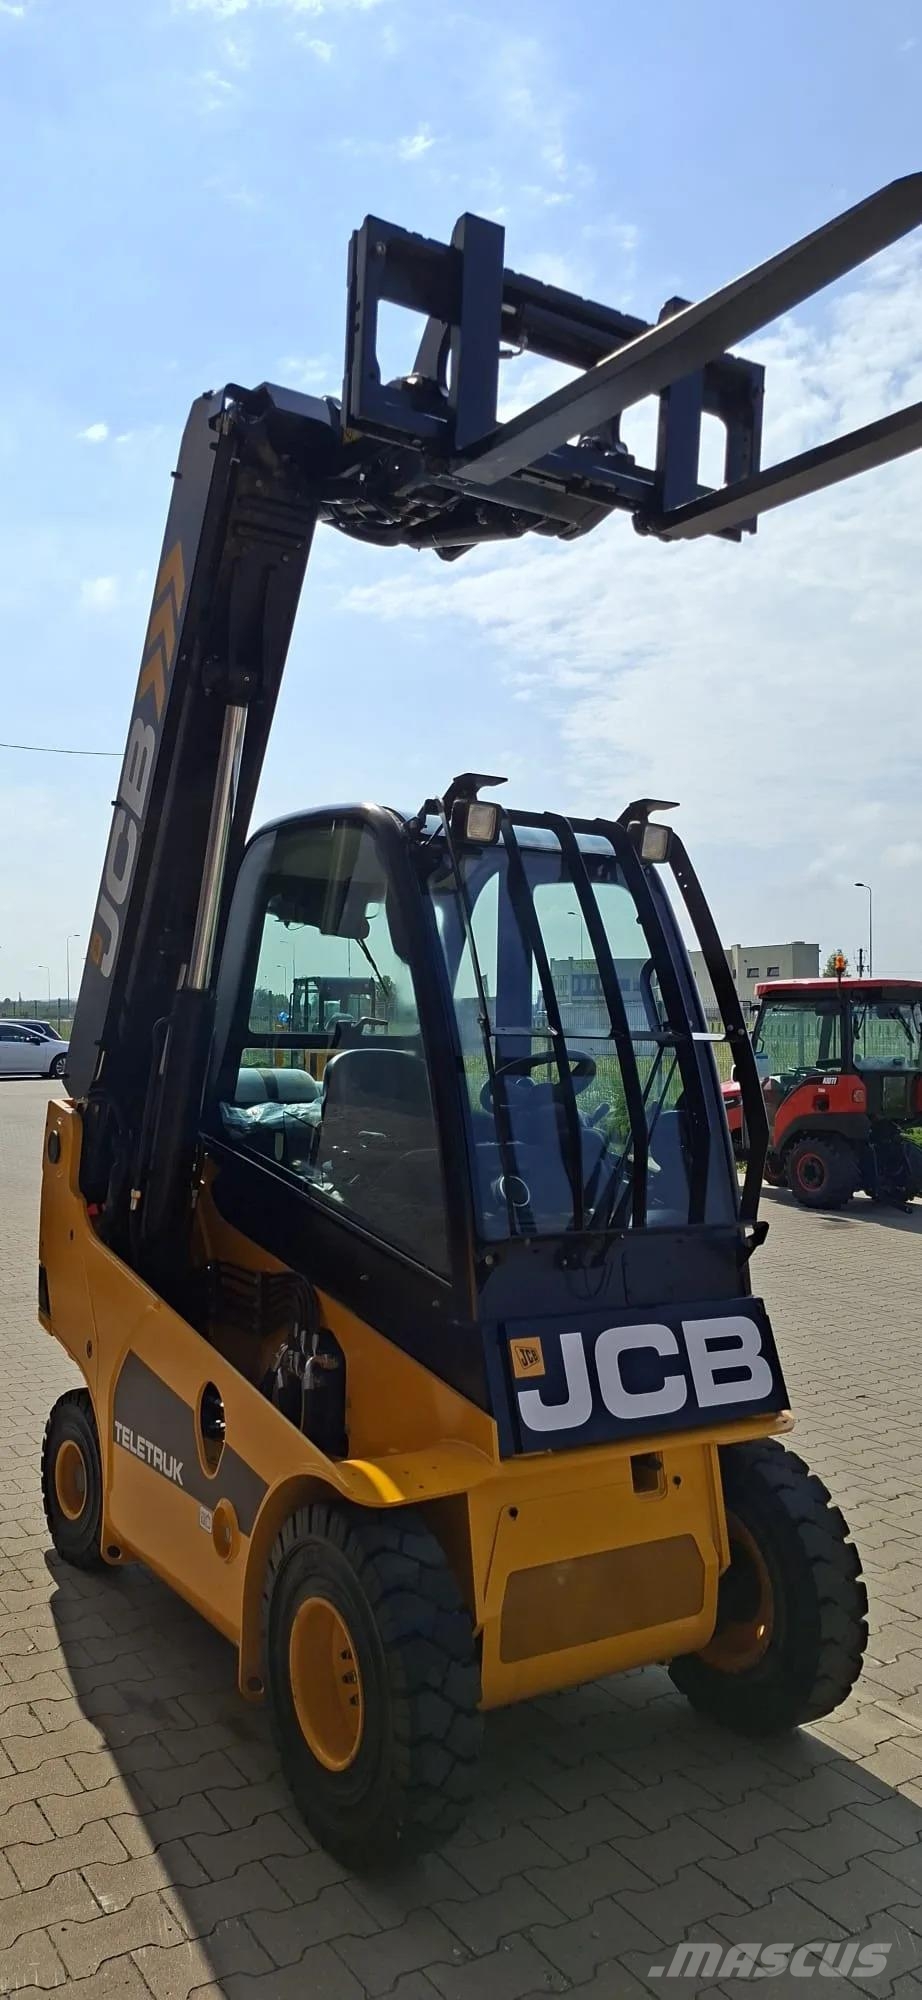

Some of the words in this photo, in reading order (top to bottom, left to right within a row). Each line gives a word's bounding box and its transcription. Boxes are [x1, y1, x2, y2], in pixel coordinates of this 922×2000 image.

[98, 717, 155, 978] JCB
[517, 1316, 773, 1432] JCB
[114, 1420, 184, 1486] TELETRUK
